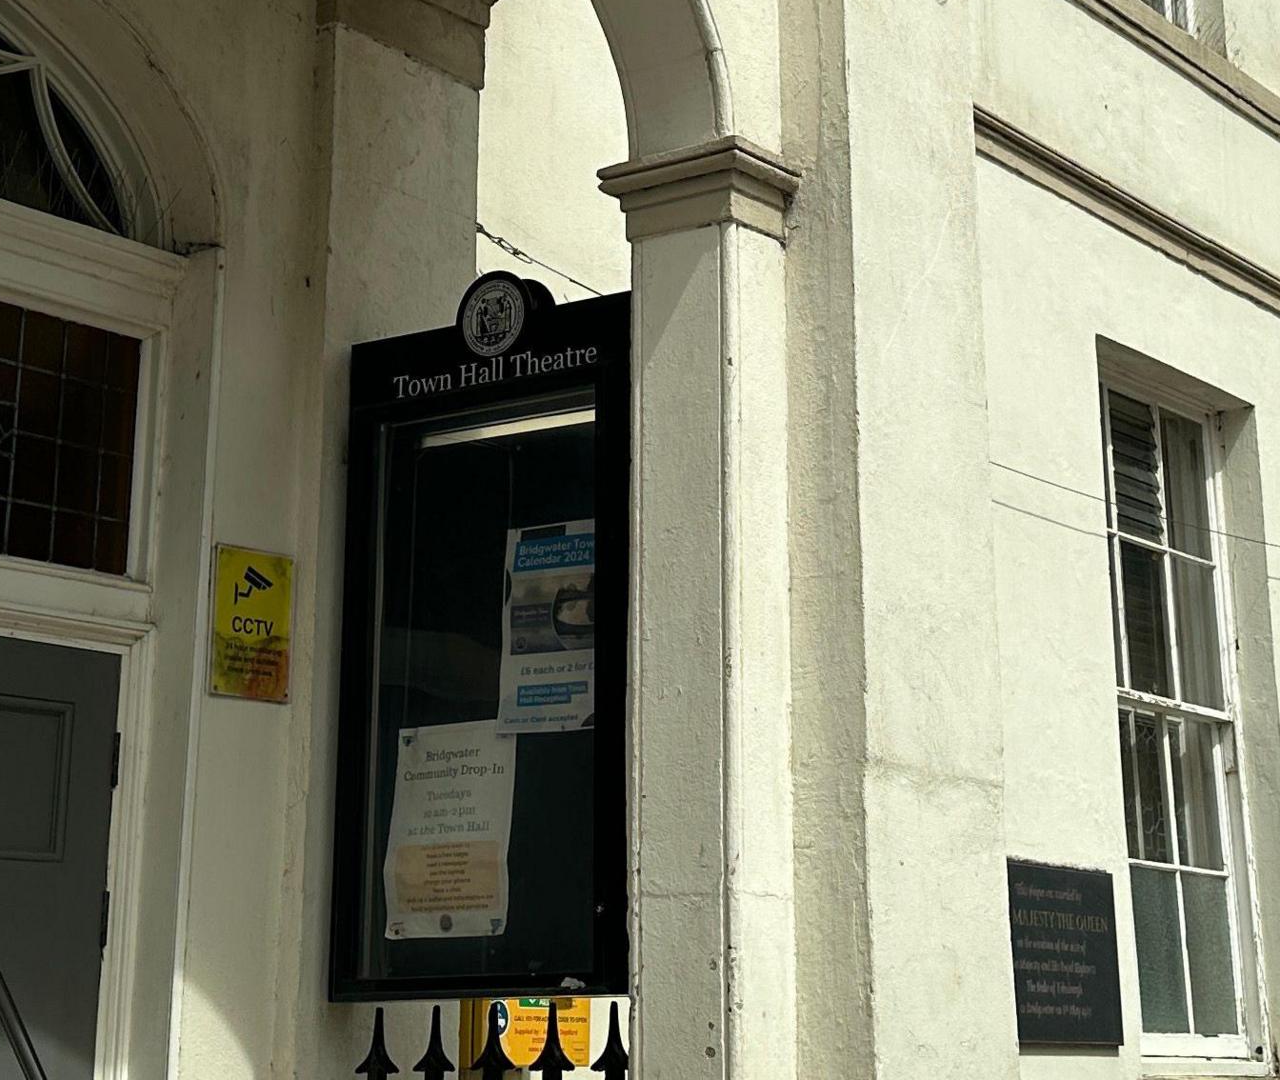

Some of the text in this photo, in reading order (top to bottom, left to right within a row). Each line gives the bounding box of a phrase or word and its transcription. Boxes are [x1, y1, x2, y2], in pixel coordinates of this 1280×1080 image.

[393, 346, 598, 399] Town Hall Theatre
[519, 541, 572, 556] Bridgwater
[517, 550, 589, 567] Calendar 2024
[232, 616, 274, 637] CCTV
[533, 665, 555, 675] each
[426, 748, 480, 763] Bridgwater
[404, 763, 504, 782] Community Drop-In
[438, 823, 464, 834] Town
[467, 821, 490, 833] Hall
[1076, 914, 1109, 934] QUEEN
